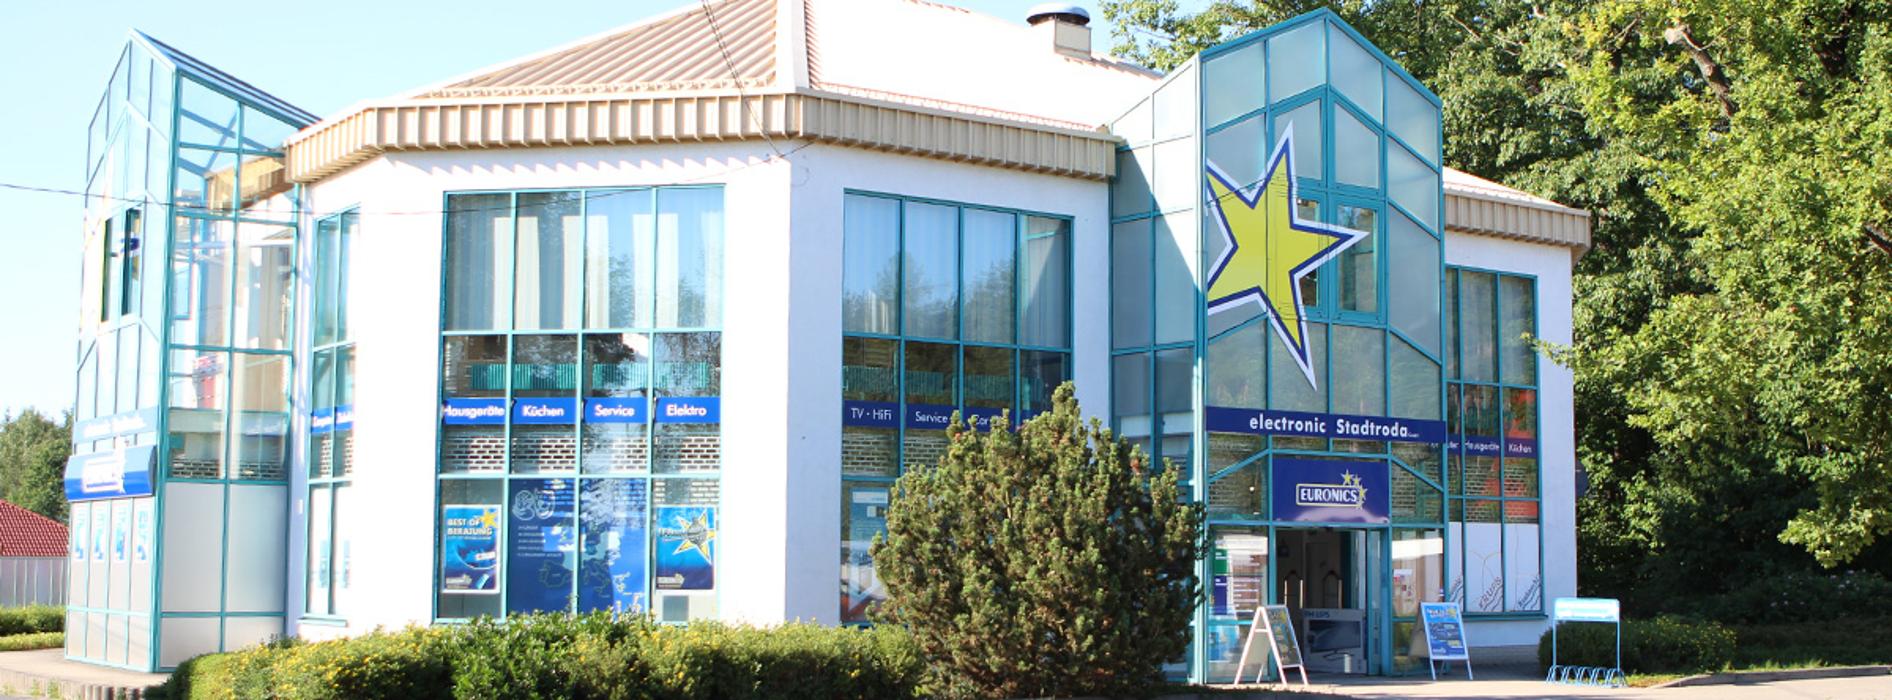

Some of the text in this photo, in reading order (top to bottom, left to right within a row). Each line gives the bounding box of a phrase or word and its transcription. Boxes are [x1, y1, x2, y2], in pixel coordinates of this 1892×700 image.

[522, 404, 564, 417] Küchen
[595, 404, 635, 416] Service
[667, 404, 707, 416] Elektro
[851, 407, 892, 420] TV HiFi
[915, 411, 948, 423] Service
[1250, 413, 1327, 433] electronic
[1336, 418, 1408, 438] Stadtroda
[1508, 442, 1532, 453] Küchen
[1300, 487, 1358, 502] EURONICS
[447, 516, 481, 526] BEST OF
